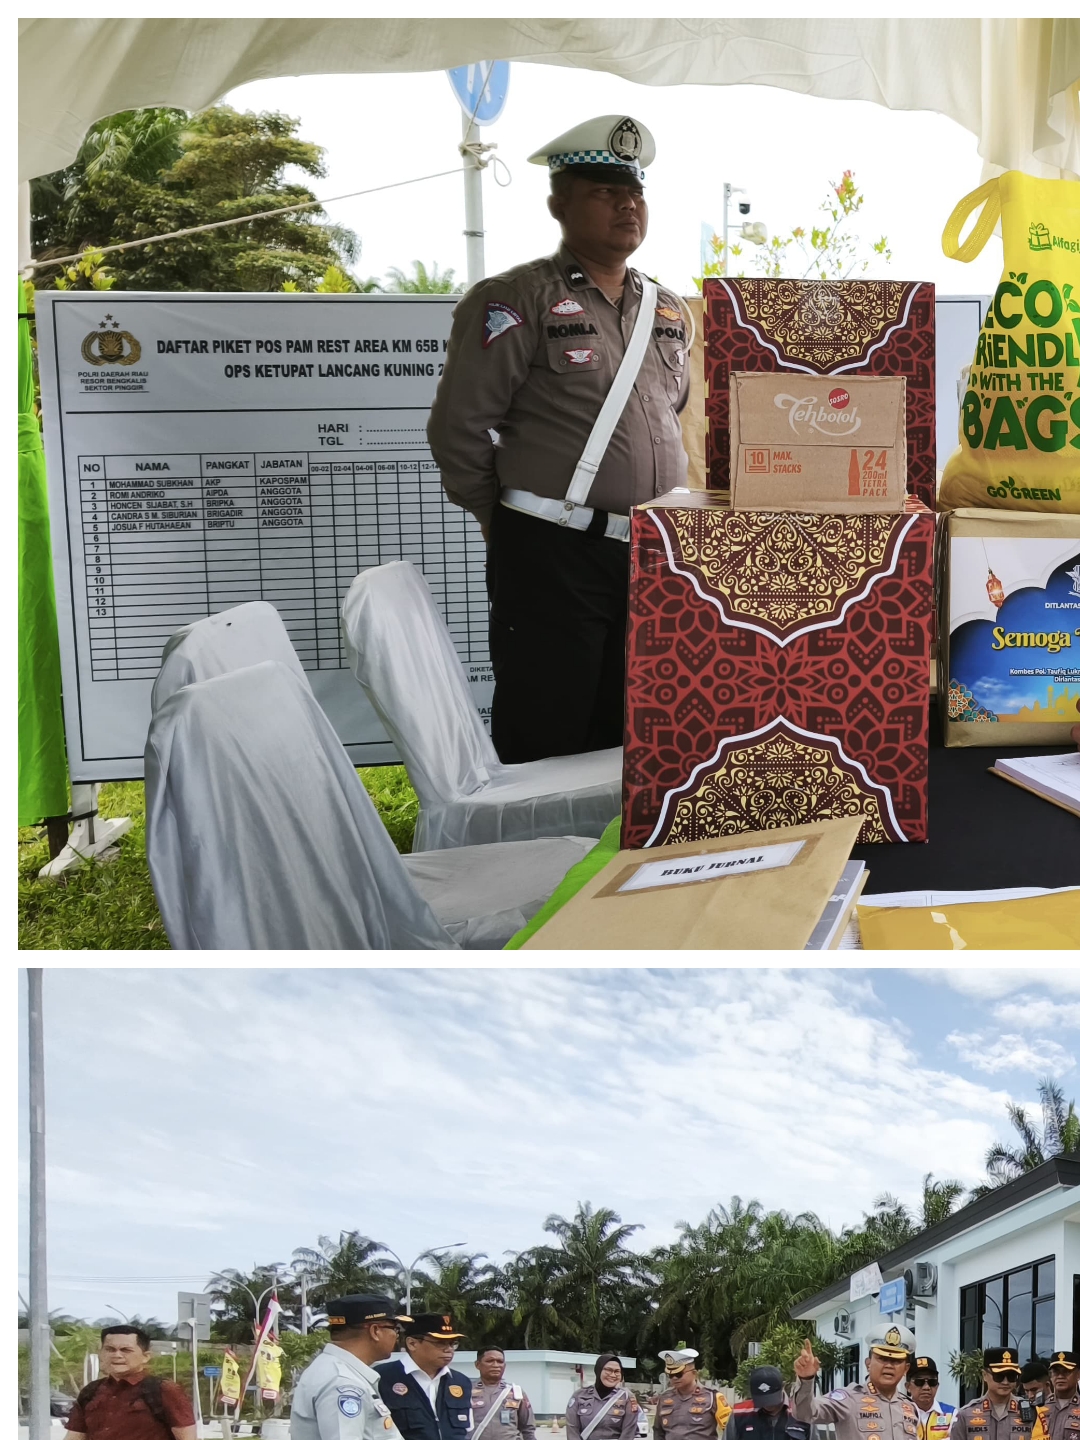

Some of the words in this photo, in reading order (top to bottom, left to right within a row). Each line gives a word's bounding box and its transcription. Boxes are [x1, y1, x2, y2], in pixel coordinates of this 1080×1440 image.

[157, 340, 208, 354] DAFTAR
[212, 340, 251, 353] PIKET
[256, 340, 282, 353] POS
[286, 340, 313, 353] PAM
[317, 340, 350, 353] REST
[354, 340, 389, 353] AREA
[392, 340, 412, 353] KM
[415, 340, 438, 352] 65B
[224, 365, 251, 378] OPS
[255, 364, 314, 377] KETUPAT
[318, 364, 380, 377] LANCANG
[384, 364, 434, 377] KUNING
[1027, 372, 1064, 391] THE
[773, 393, 862, 437] Tehbotol
[318, 424, 349, 433] HARI
[318, 437, 344, 446] TGL
[750, 452, 764, 465] 10
[773, 451, 793, 461] MAX.
[863, 450, 887, 470] 24
[83, 463, 100, 472] NO
[135, 462, 170, 471] NAMA
[206, 460, 250, 470] PANGKAT
[260, 459, 303, 469] JABATAN
[773, 464, 802, 473] STACKS
[90, 481, 95, 489] 1
[109, 480, 155, 488] MOHAMMAD
[156, 479, 194, 487] SUBKHAN
[205, 478, 221, 486] AKP
[259, 477, 308, 485] KAPOSPAM
[863, 479, 887, 488] TETRA
[206, 489, 228, 497] AIPDA
[260, 487, 302, 495] ANGGOTA
[863, 488, 888, 497] PACK
[986, 485, 1006, 498] GO
[1011, 487, 1061, 501] GREEN
[91, 492, 97, 500] 2
[206, 499, 234, 507] BRIPKA
[261, 498, 302, 506] ANGGOTA
[111, 513, 144, 521] CANDRA
[161, 511, 198, 519] SIBURIAN
[261, 508, 303, 516] ANGGOTA
[112, 523, 137, 531] JOSUA
[145, 521, 191, 530] HUTAHAEAN
[207, 520, 235, 528] BRIPTU
[262, 518, 304, 526] ANGGOTA
[93, 524, 98, 532] 5
[96, 566, 102, 574] 9
[94, 587, 105, 595] 11
[96, 608, 107, 616] 13
[991, 626, 1072, 653] Semoga
[1047, 668, 1066, 676] Taufiq
[660, 864, 706, 877] BUKU
[706, 855, 765, 871] JURNAL
